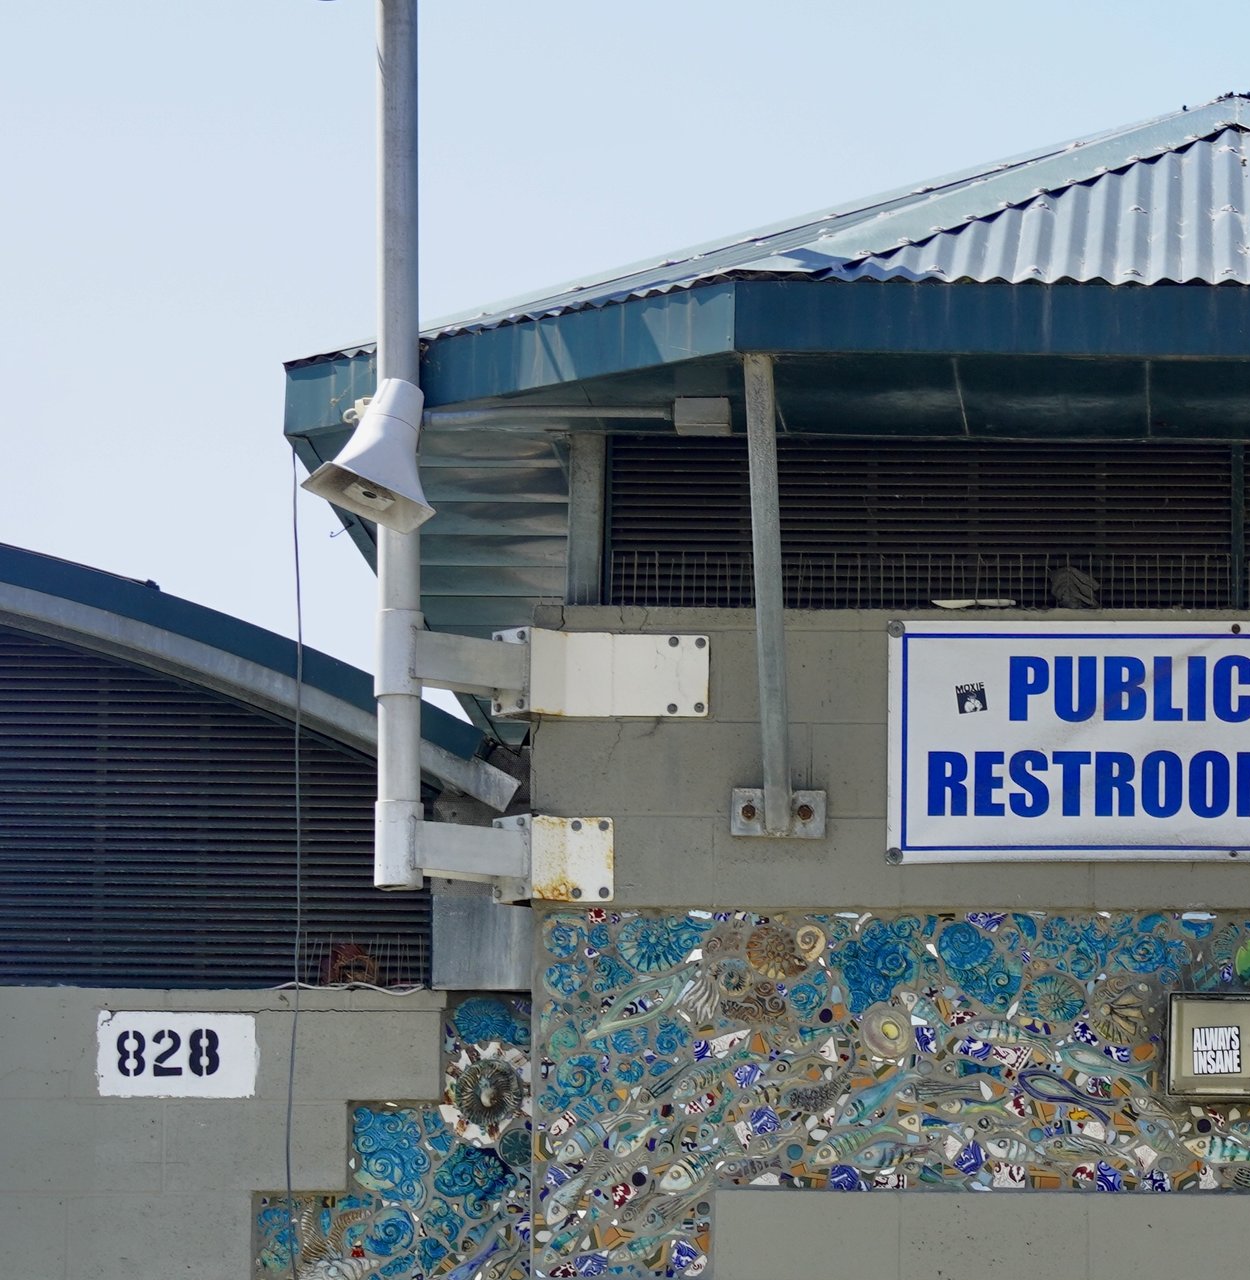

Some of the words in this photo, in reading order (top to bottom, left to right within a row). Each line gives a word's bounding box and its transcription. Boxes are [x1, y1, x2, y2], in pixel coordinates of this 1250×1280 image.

[955, 681, 985, 694] MOXIE
[1193, 1026, 1239, 1051] ALWAYS
[116, 1028, 220, 1077] 828
[1193, 1050, 1241, 1074] INSANE
